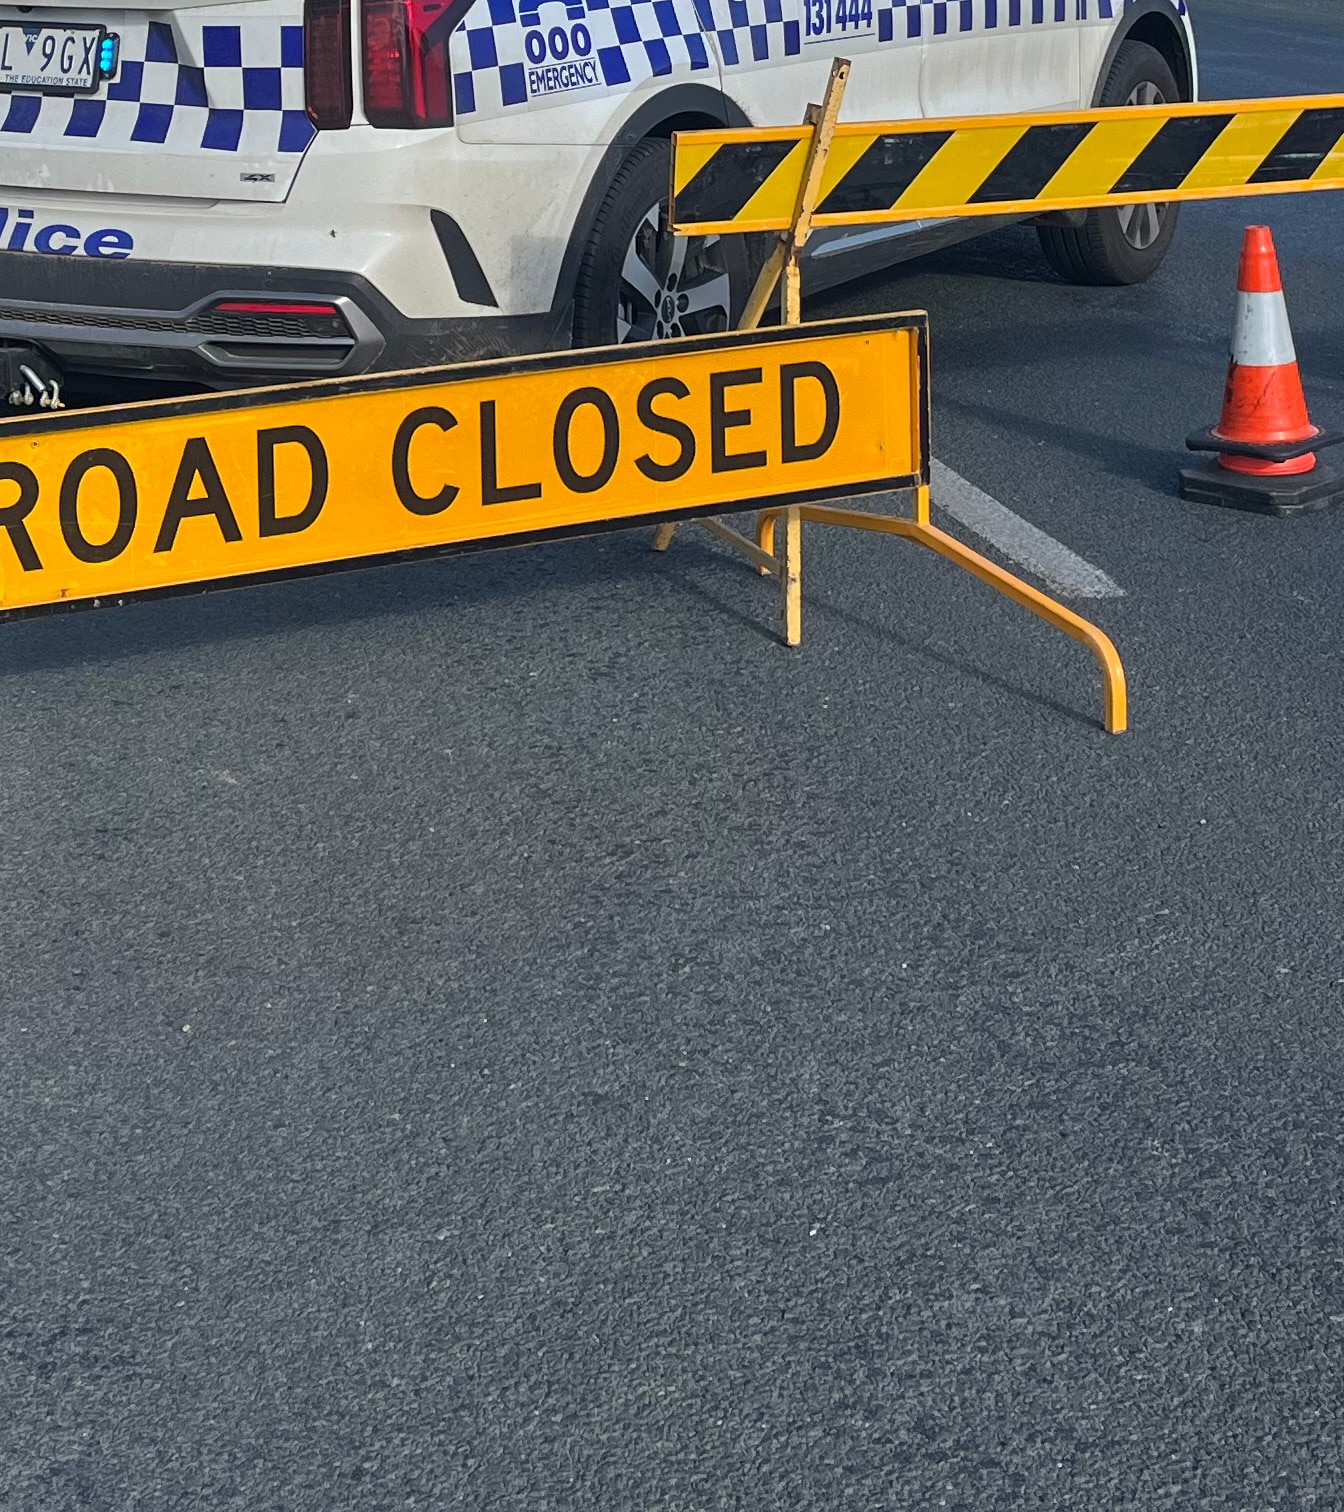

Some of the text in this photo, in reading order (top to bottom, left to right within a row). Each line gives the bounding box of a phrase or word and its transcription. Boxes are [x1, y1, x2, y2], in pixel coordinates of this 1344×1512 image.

[40, 35, 95, 76] 9GX
[525, 23, 592, 65] 000
[5, 73, 19, 82] THE
[21, 74, 63, 85] EDUCATION
[65, 77, 88, 87] STATE
[528, 60, 599, 94] EMERGENCY
[391, 360, 841, 517] CLOSED
